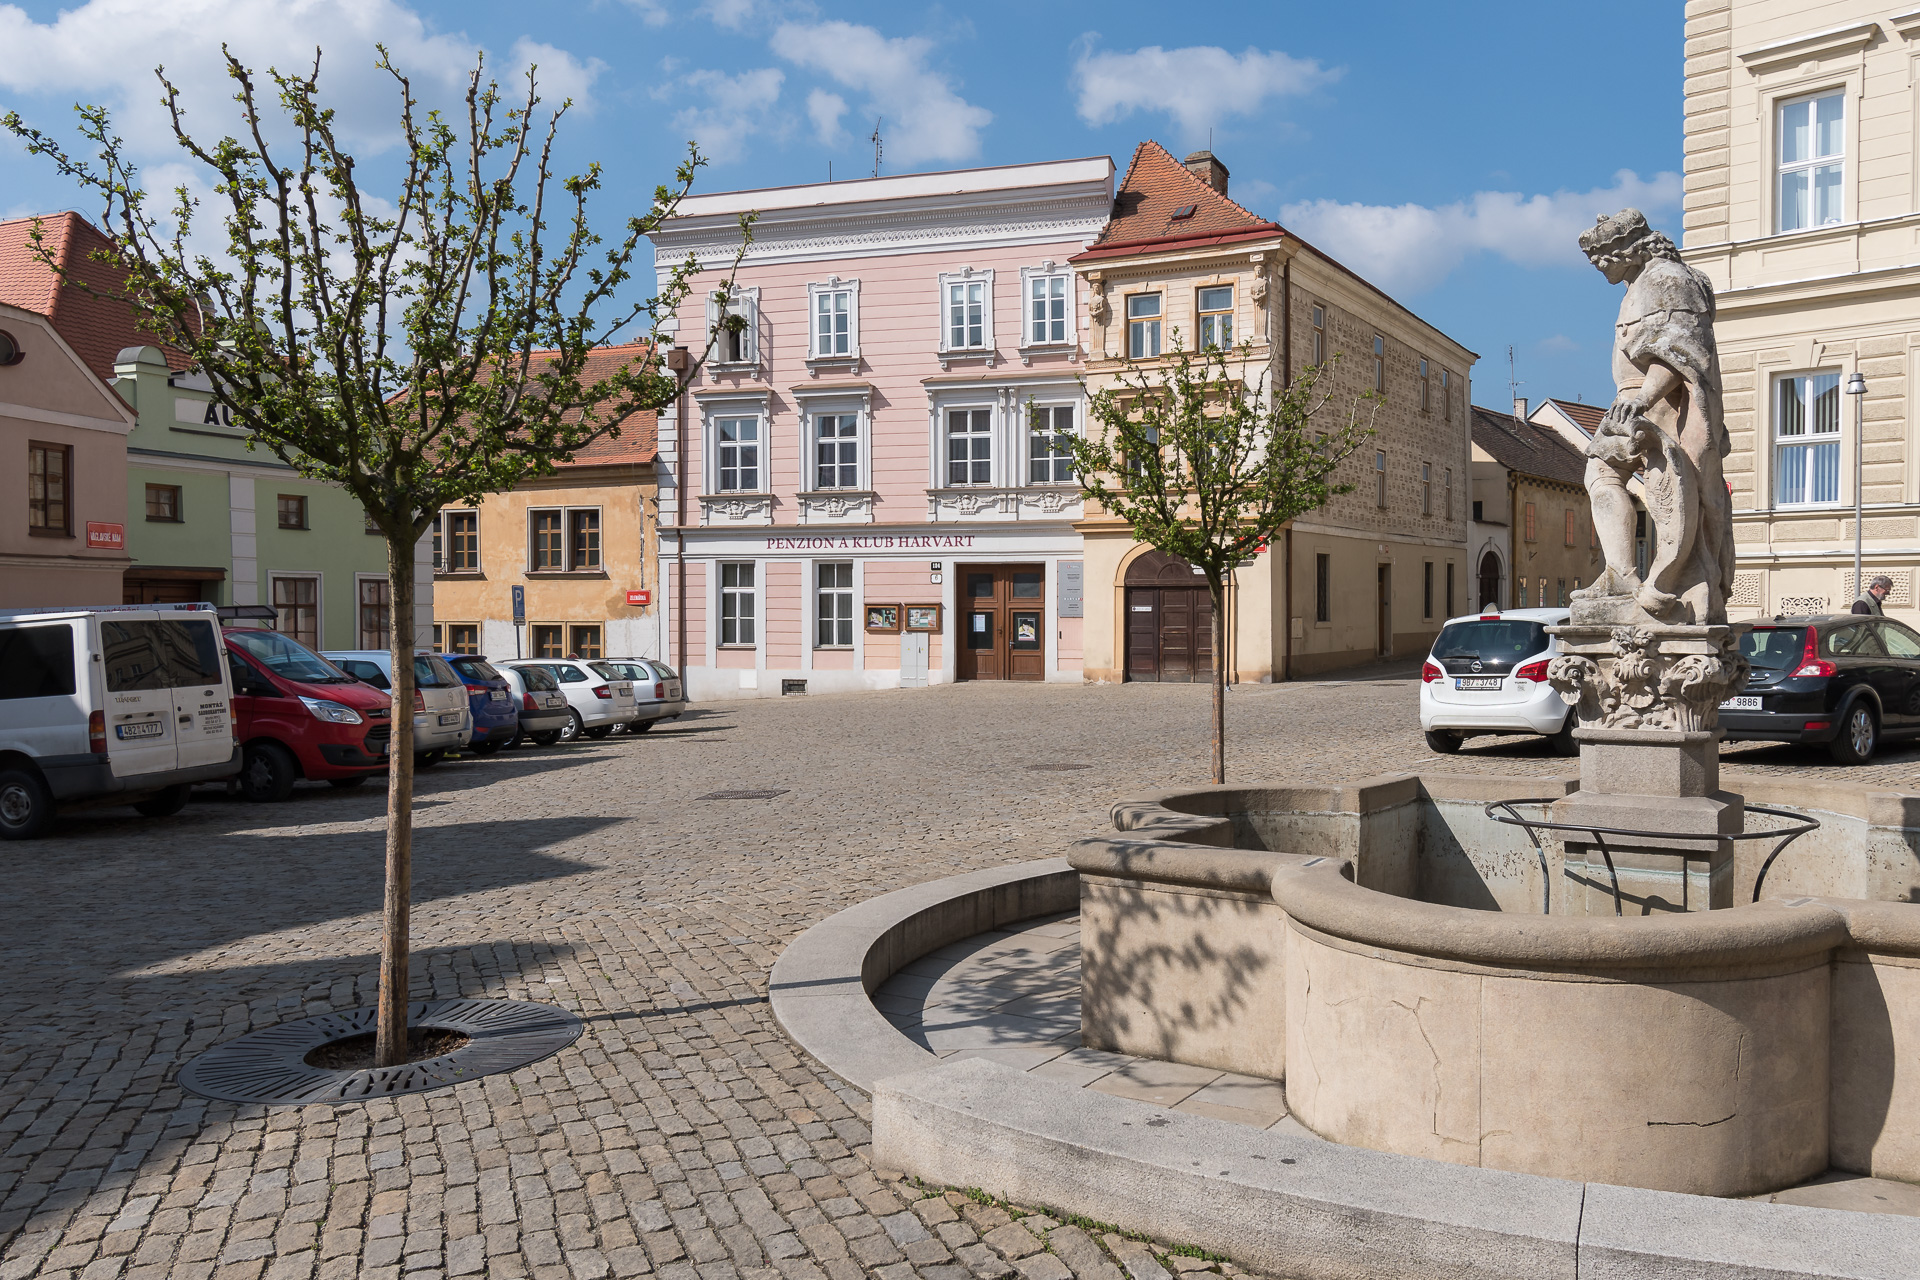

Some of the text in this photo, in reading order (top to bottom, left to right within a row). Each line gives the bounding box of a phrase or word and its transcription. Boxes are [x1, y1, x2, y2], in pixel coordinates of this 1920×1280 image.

[766, 535, 975, 550] PENZION A KLUB HARVART
[515, 589, 522, 608] P
[1462, 678, 1498, 687] 9B7 3748
[1736, 697, 1758, 707] 9886
[124, 723, 158, 736] 4B2 4177
